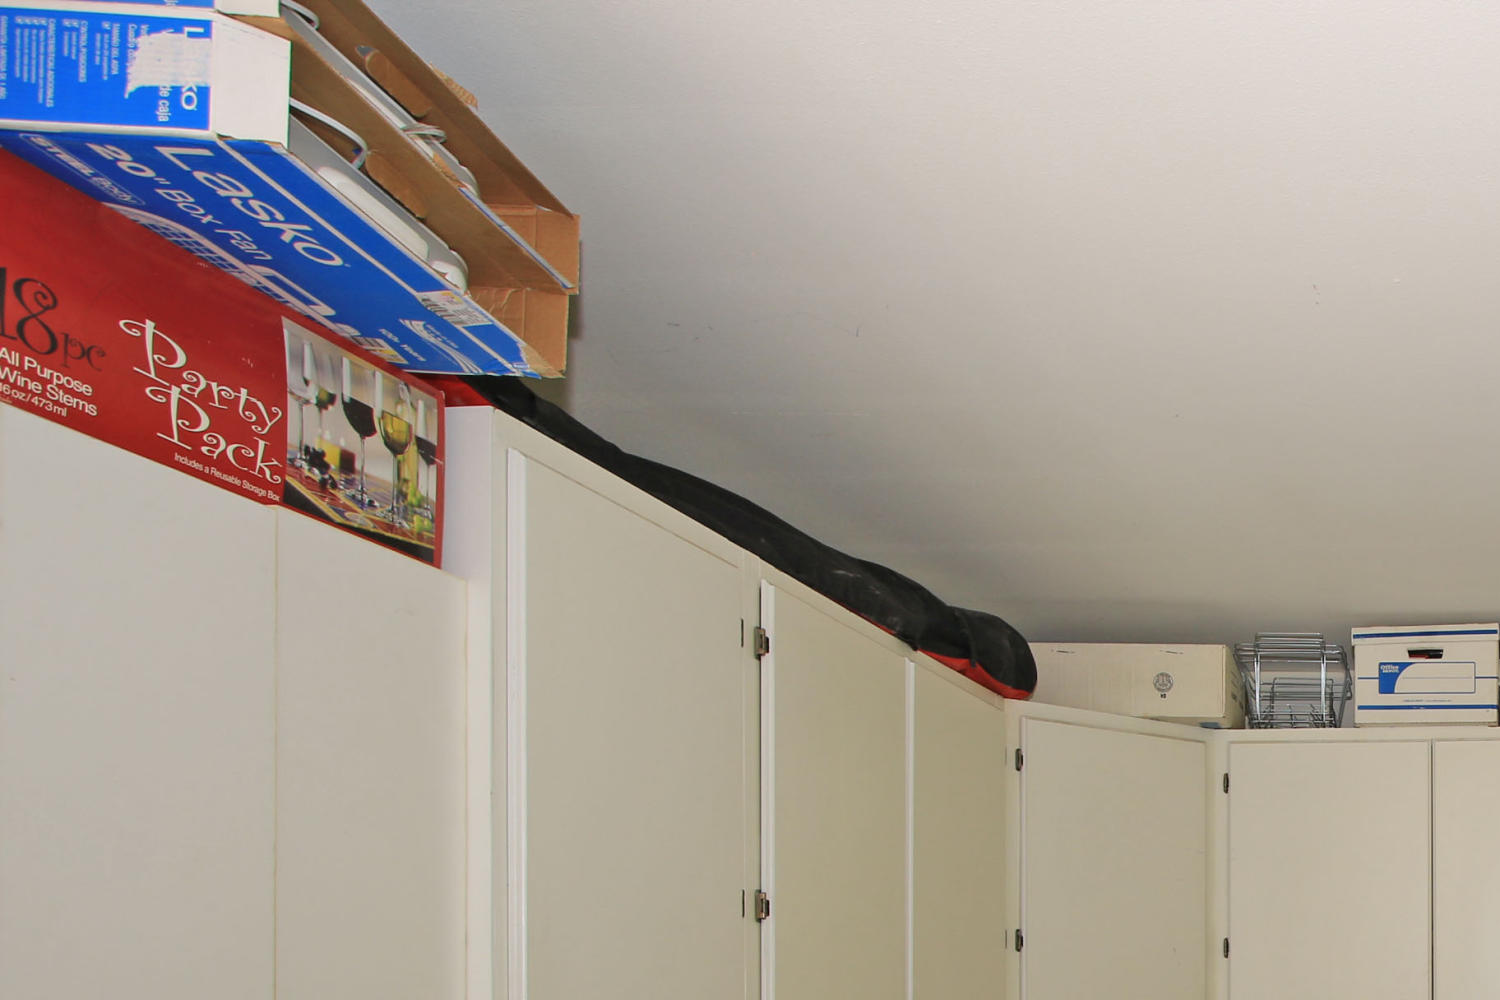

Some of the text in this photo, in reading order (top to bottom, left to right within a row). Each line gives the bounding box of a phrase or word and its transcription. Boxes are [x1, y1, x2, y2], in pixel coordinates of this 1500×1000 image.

[155, 100, 172, 122] caja
[91, 177, 138, 204] Body
[154, 146, 343, 266] Lasko
[155, 188, 223, 224] Box
[215, 229, 273, 260] Fan
[0, 347, 94, 397] All Purpose
[60, 332, 106, 372] pc
[119, 318, 283, 435] Party
[0, 366, 98, 417] Wine Stems
[145, 385, 283, 485] Pack
[174, 452, 281, 502] Includes a Reusable Storage Box
